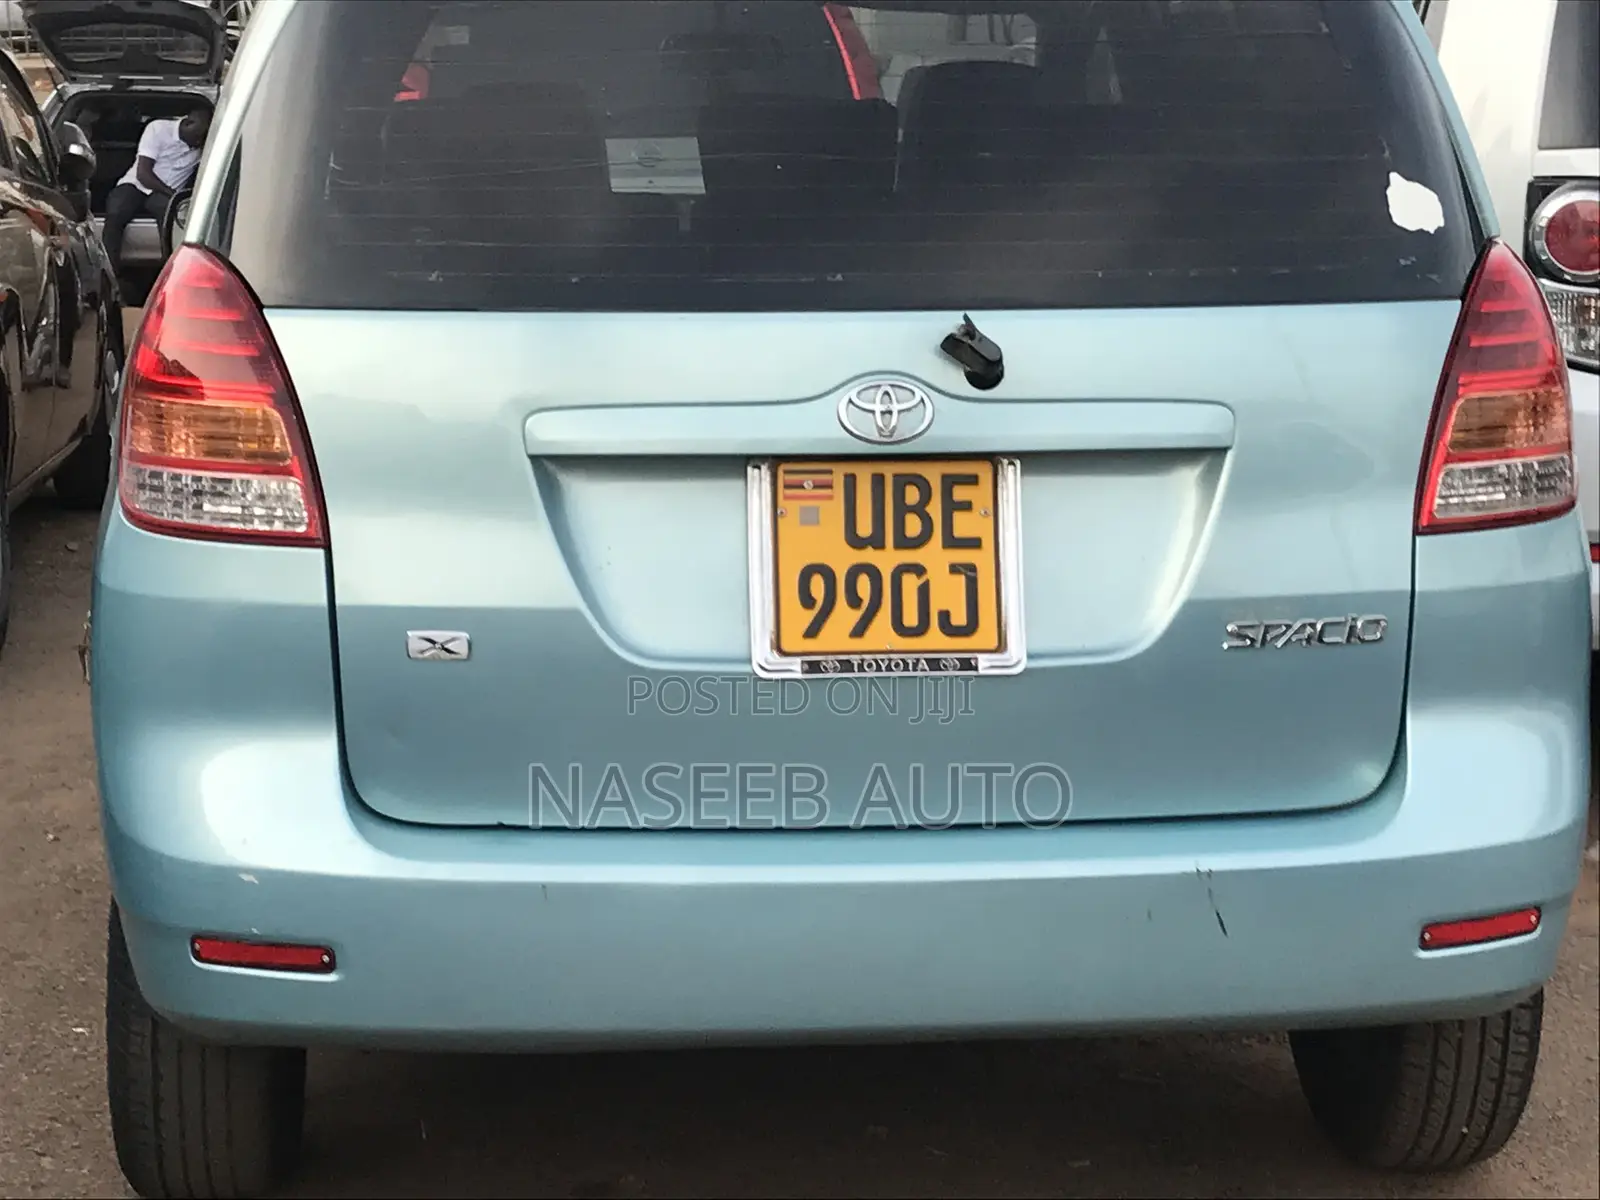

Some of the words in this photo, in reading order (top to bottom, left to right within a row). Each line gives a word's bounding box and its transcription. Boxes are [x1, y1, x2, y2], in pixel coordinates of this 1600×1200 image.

[843, 472, 983, 550] UBE
[797, 562, 980, 639] 990J
[851, 658, 930, 673] TOYOTA
